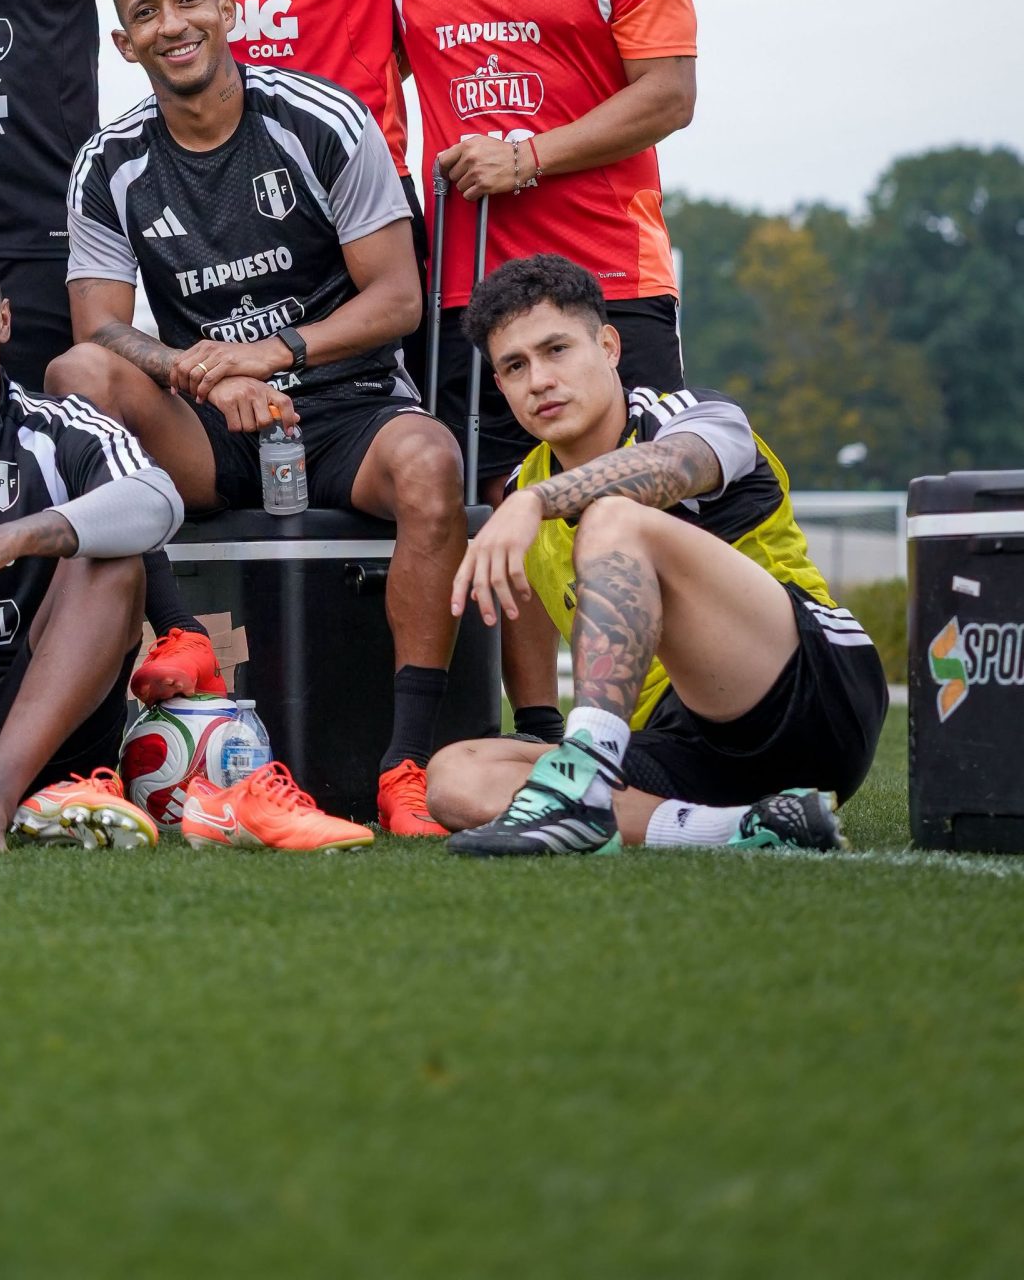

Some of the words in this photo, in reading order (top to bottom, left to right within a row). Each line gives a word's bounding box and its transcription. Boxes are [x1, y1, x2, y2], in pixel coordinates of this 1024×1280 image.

[248, 43, 295, 59] COLA
[435, 24, 457, 51] TE
[457, 21, 541, 45] APUESTO
[456, 78, 536, 114] CRISTAL
[260, 185, 287, 201] FPF
[176, 270, 202, 297] TE
[203, 246, 293, 289] APUESTO
